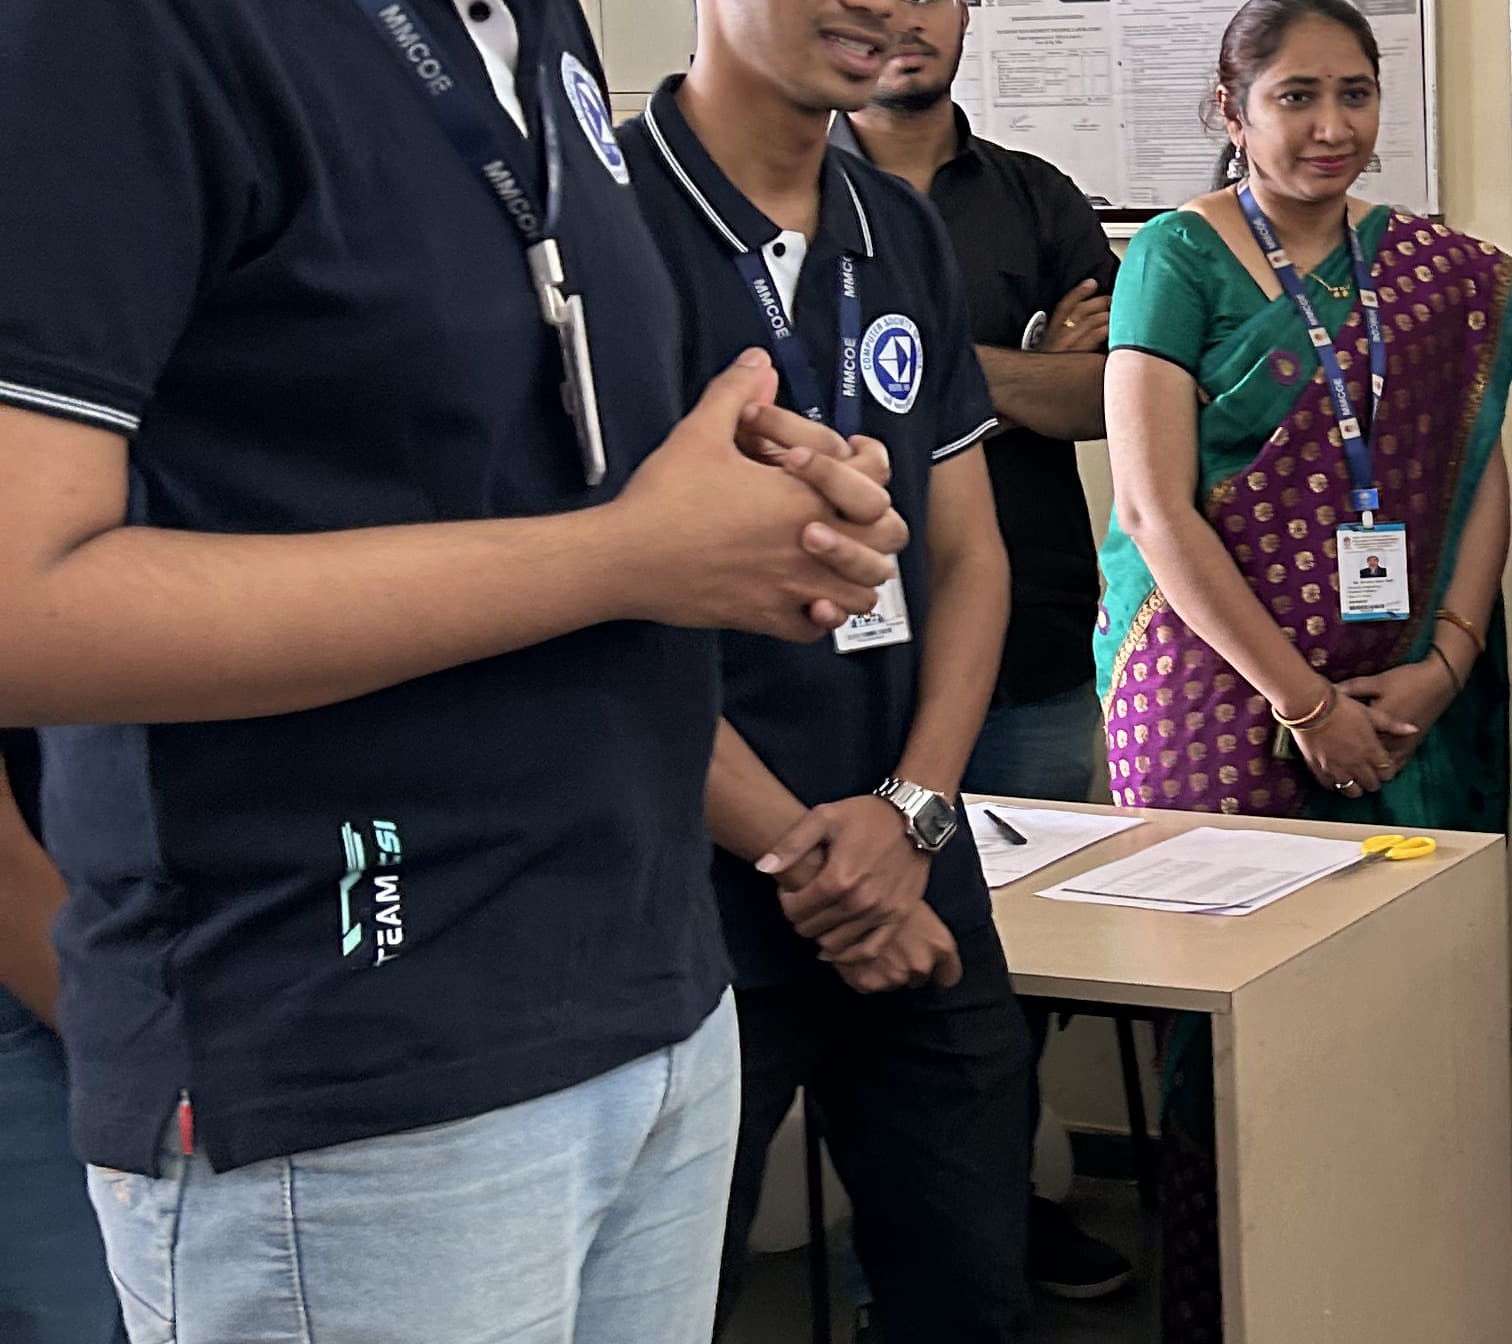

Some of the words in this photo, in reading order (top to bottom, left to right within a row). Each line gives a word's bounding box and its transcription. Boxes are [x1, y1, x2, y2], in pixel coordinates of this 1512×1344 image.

[378, 4, 453, 97] MMCOE
[753, 278, 792, 340] MMCOE
[842, 337, 857, 397] MMCOE
[862, 322, 884, 370] COMPUTER
[1333, 377, 1353, 417] MMCOE
[373, 874, 404, 968] TEAM
